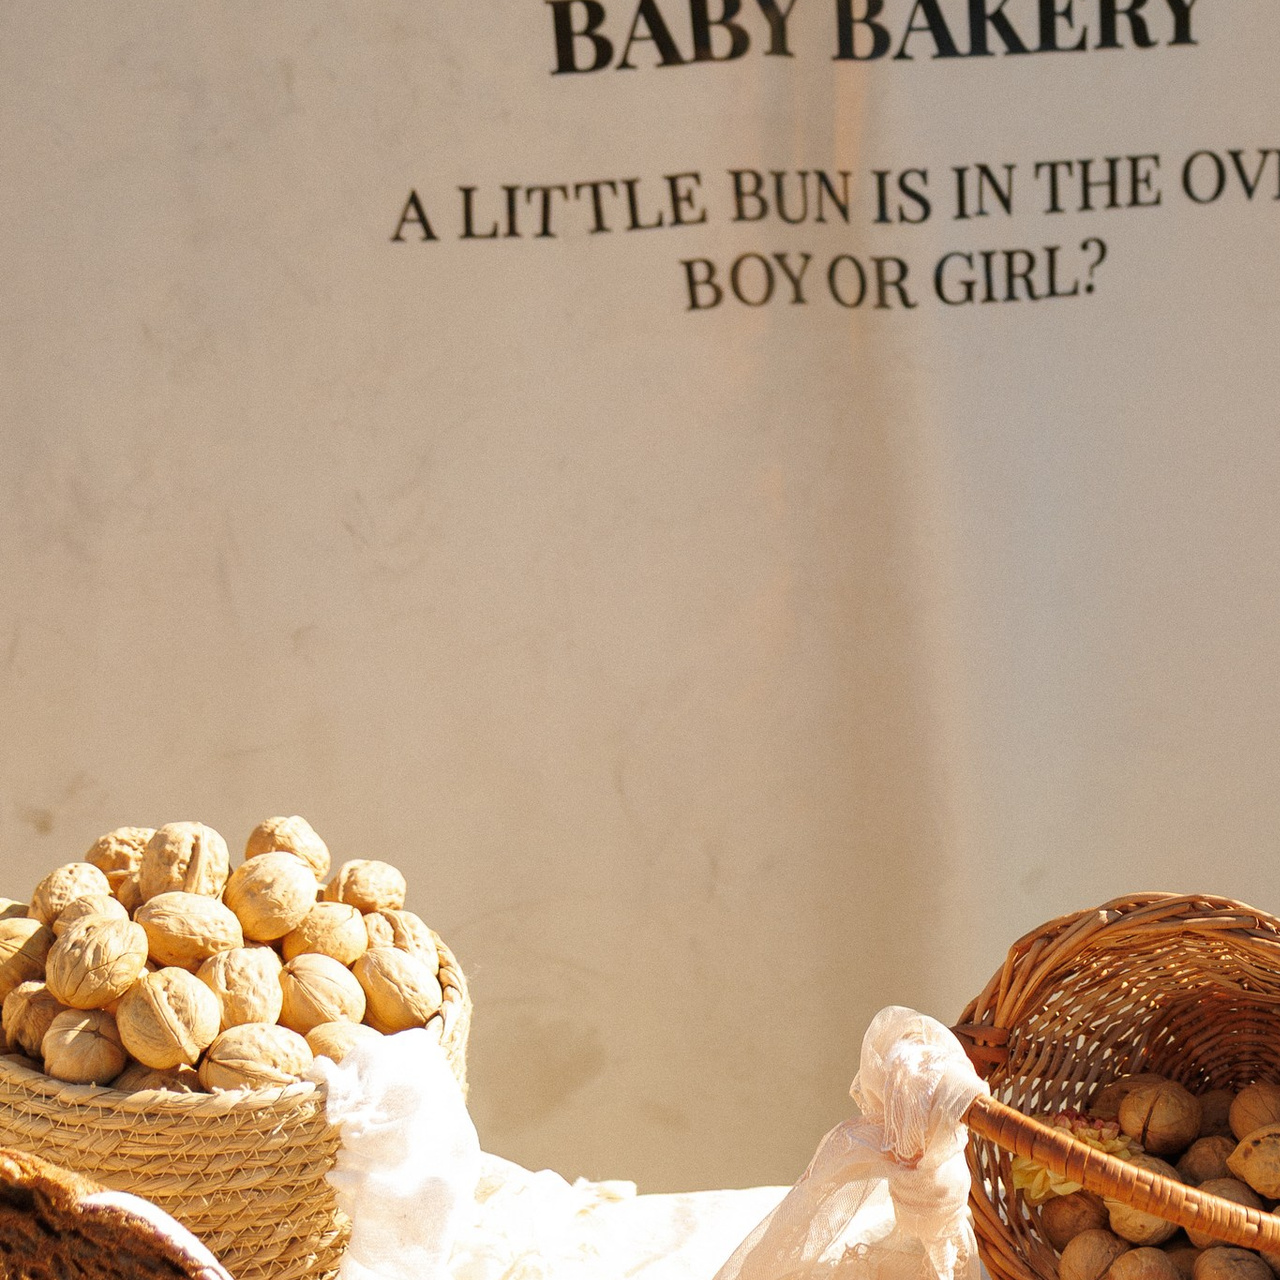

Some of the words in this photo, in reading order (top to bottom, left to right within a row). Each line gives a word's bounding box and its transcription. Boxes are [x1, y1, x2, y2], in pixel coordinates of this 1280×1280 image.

[389, 189, 440, 244] A
[457, 170, 710, 241] LITTLE
[727, 168, 853, 226] BUN
[871, 167, 934, 226] IS
[951, 162, 1019, 222] IN
[1033, 153, 1164, 215] THE
[679, 251, 815, 312] BOY
[825, 252, 920, 311] OR
[932, 236, 1110, 307] GIRL?
